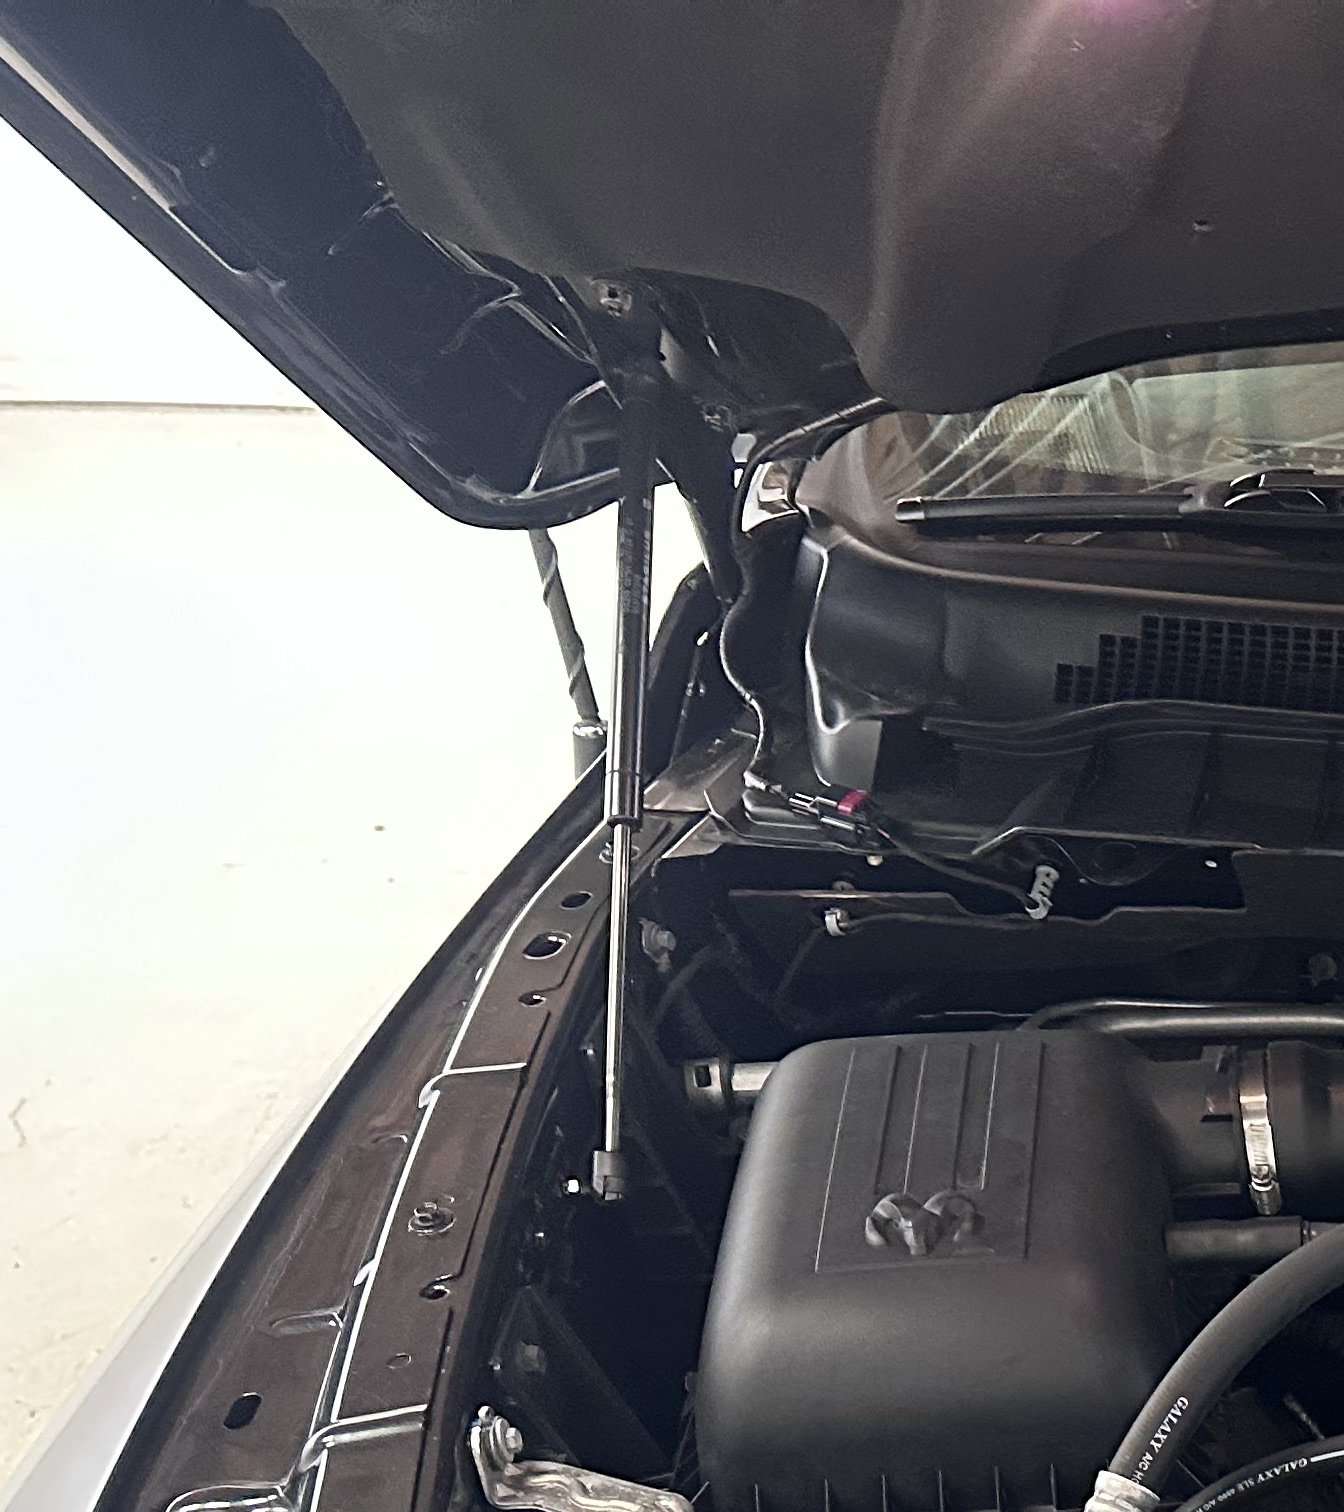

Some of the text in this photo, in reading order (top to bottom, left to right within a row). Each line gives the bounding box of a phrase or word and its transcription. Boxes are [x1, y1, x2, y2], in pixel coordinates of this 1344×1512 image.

[1149, 1396, 1189, 1454] GALAXY
[1138, 1451, 1154, 1471] A/C
[1257, 1457, 1309, 1483] GALAXY
